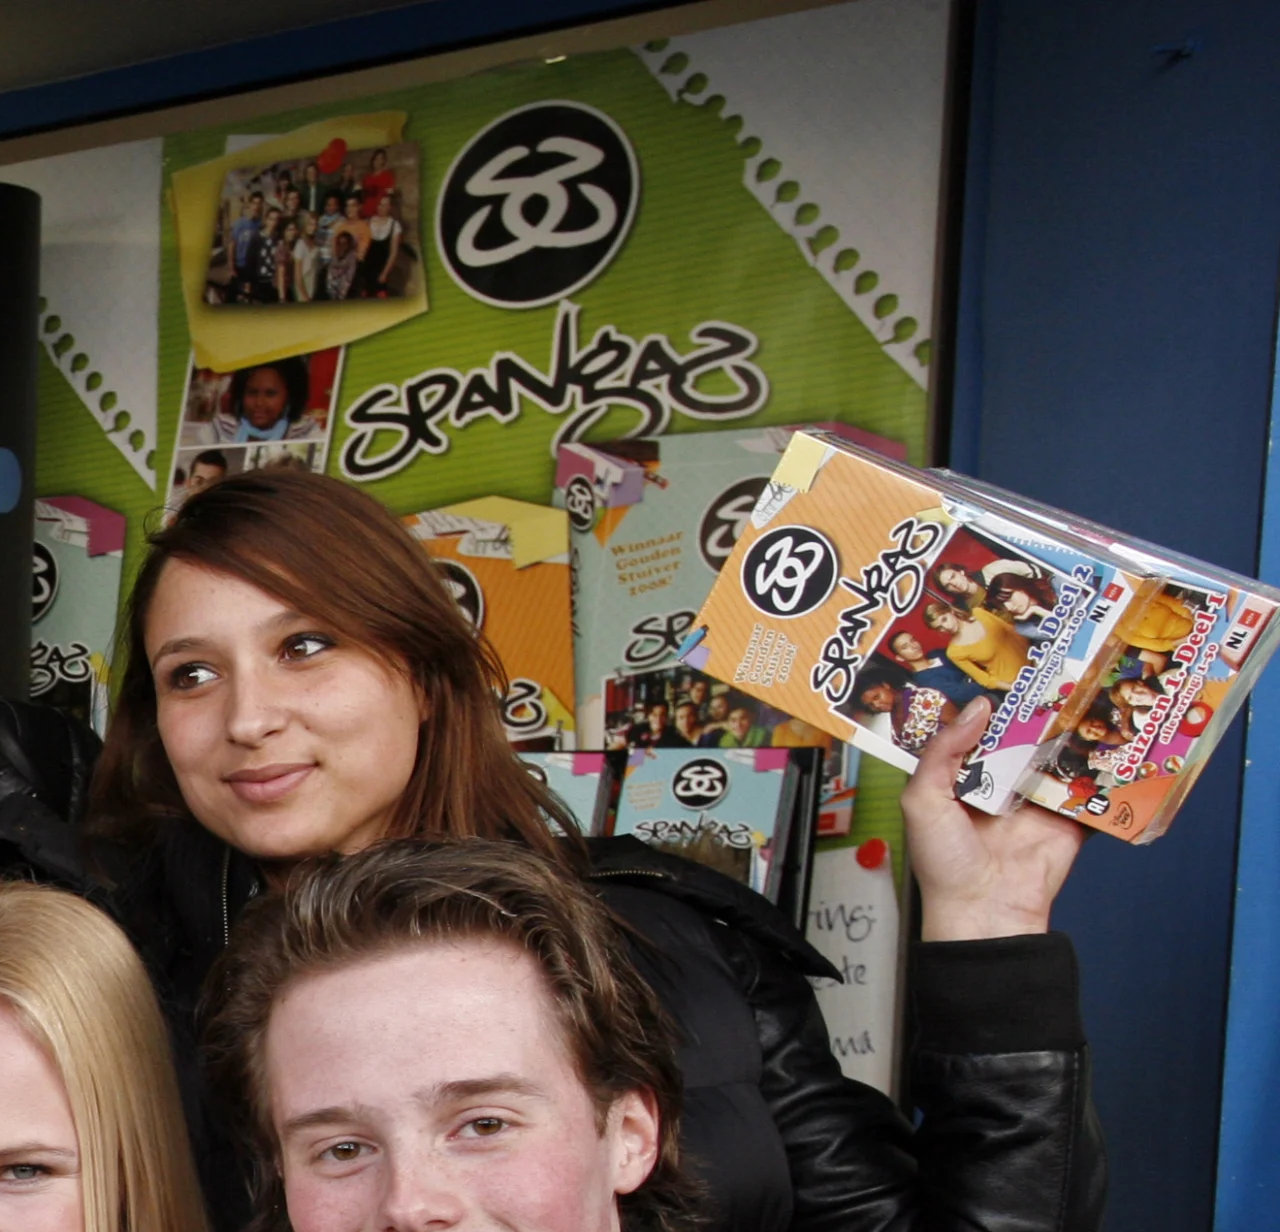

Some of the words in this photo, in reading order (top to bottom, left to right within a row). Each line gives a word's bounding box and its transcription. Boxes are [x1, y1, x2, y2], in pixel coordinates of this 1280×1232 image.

[611, 531, 684, 556] Winnaar
[615, 546, 682, 571] Gouden
[617, 560, 681, 585] Stuiver
[1090, 602, 1110, 624] NL
[734, 624, 763, 684] Winnaar
[749, 630, 775, 684] Gouden
[761, 633, 788, 687] Stuiver
[979, 664, 1034, 751] Seizoen
[1042, 583, 1079, 637] Deel
[1073, 565, 1091, 582] 2
[1226, 628, 1248, 650] NL
[777, 644, 797, 682] 2008!
[1019, 654, 1061, 723] aflevering:
[1116, 696, 1171, 780] Seizoen
[1175, 612, 1217, 666] Deel
[1160, 675, 1202, 744] aflevering:
[1088, 796, 1109, 814] AL
